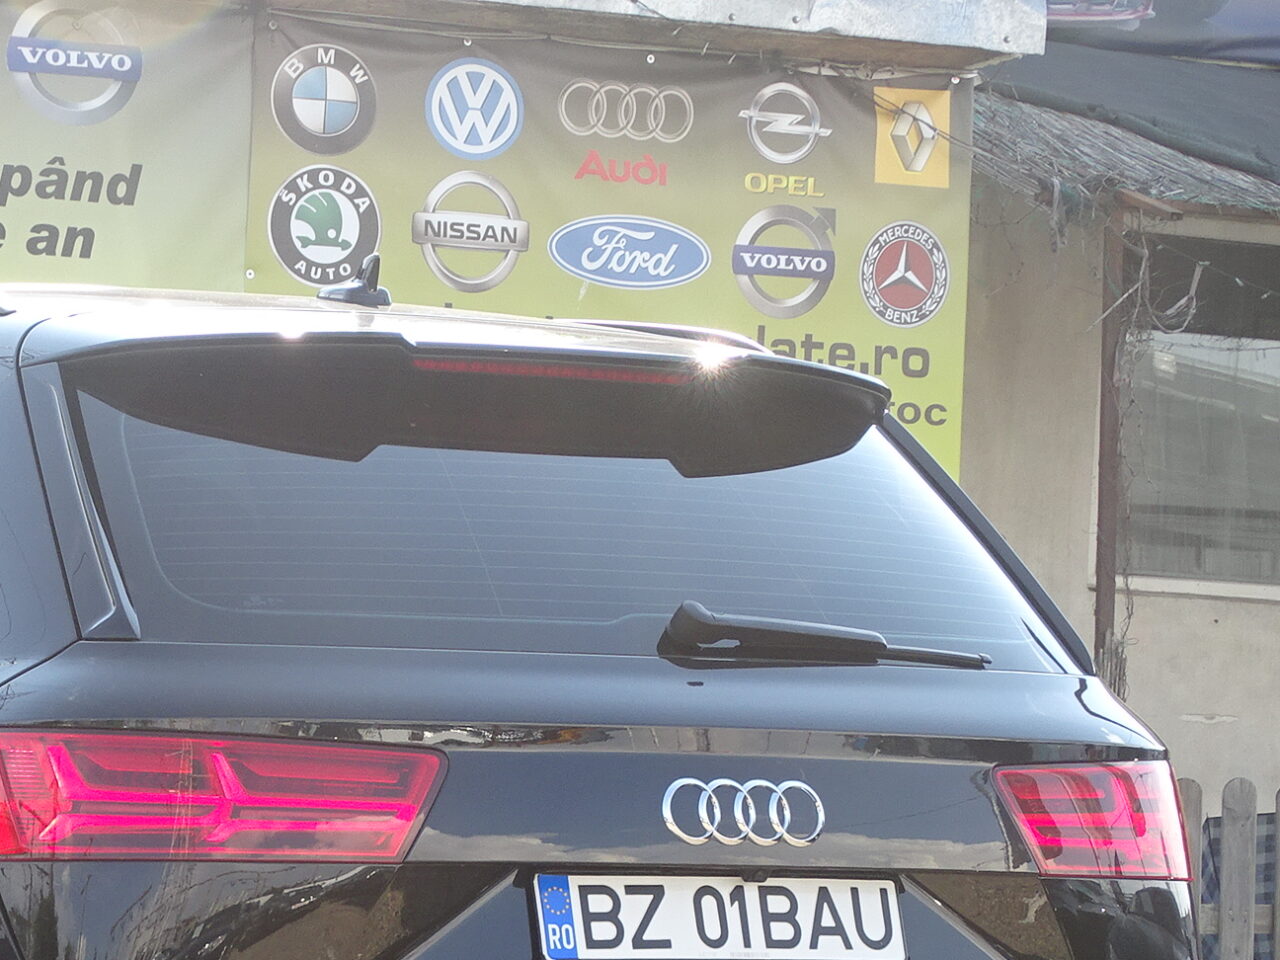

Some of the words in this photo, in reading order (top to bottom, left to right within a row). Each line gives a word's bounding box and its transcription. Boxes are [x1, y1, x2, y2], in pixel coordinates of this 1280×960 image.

[17, 46, 132, 71] VOLVO
[283, 48, 368, 84] BMW
[743, 172, 826, 198] OPEL
[26, 221, 96, 259] an
[424, 219, 518, 244] NISSAN
[878, 225, 935, 250] MERCEDES
[581, 225, 679, 277] Ford
[740, 252, 827, 272] VOLVO
[294, 259, 352, 280] AUTO
[885, 308, 920, 324] BENZ
[578, 884, 673, 950] BZ
[692, 884, 895, 950] 01BAU
[548, 923, 575, 950] RO
